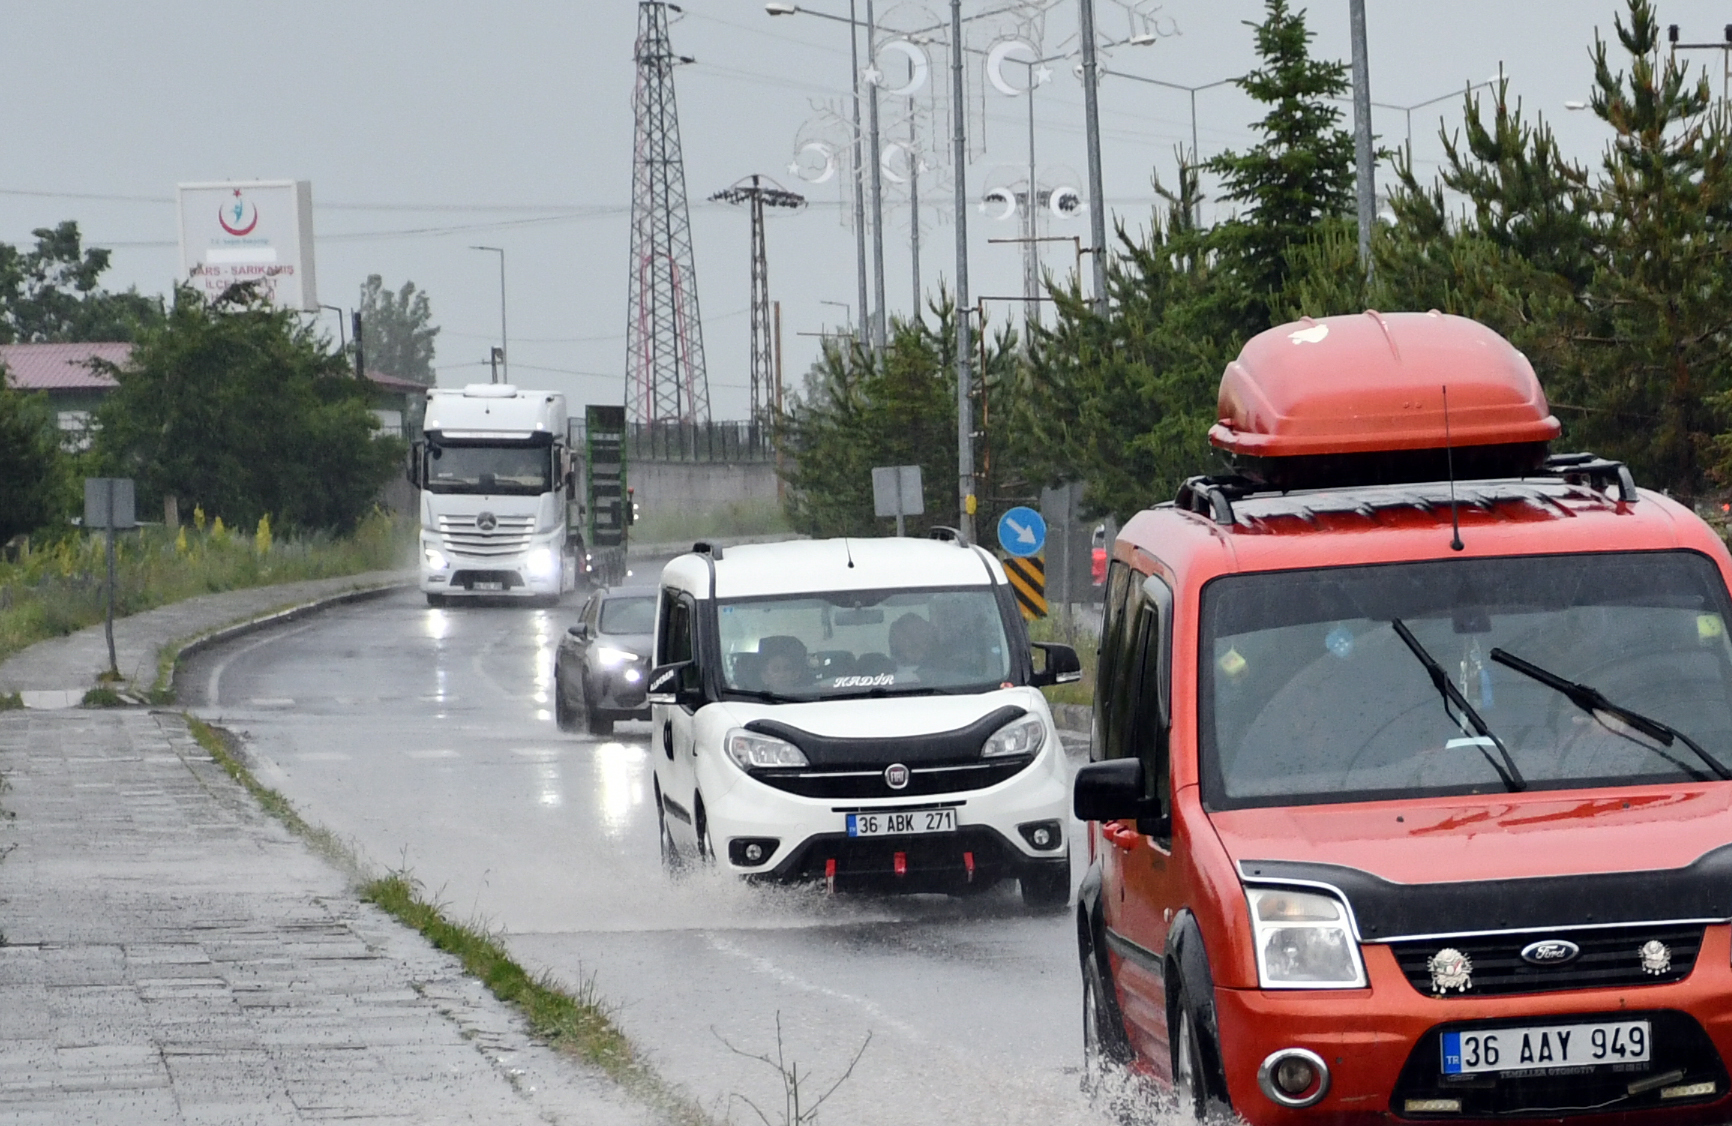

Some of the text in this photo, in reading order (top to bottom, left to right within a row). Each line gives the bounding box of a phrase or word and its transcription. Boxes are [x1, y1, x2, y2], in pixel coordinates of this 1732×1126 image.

[859, 816, 878, 834] 36
[887, 814, 915, 833] ABK
[925, 812, 952, 830] 271
[1535, 944, 1567, 960] Ford
[1446, 1026, 1645, 1067] TR 36 AAY 949
